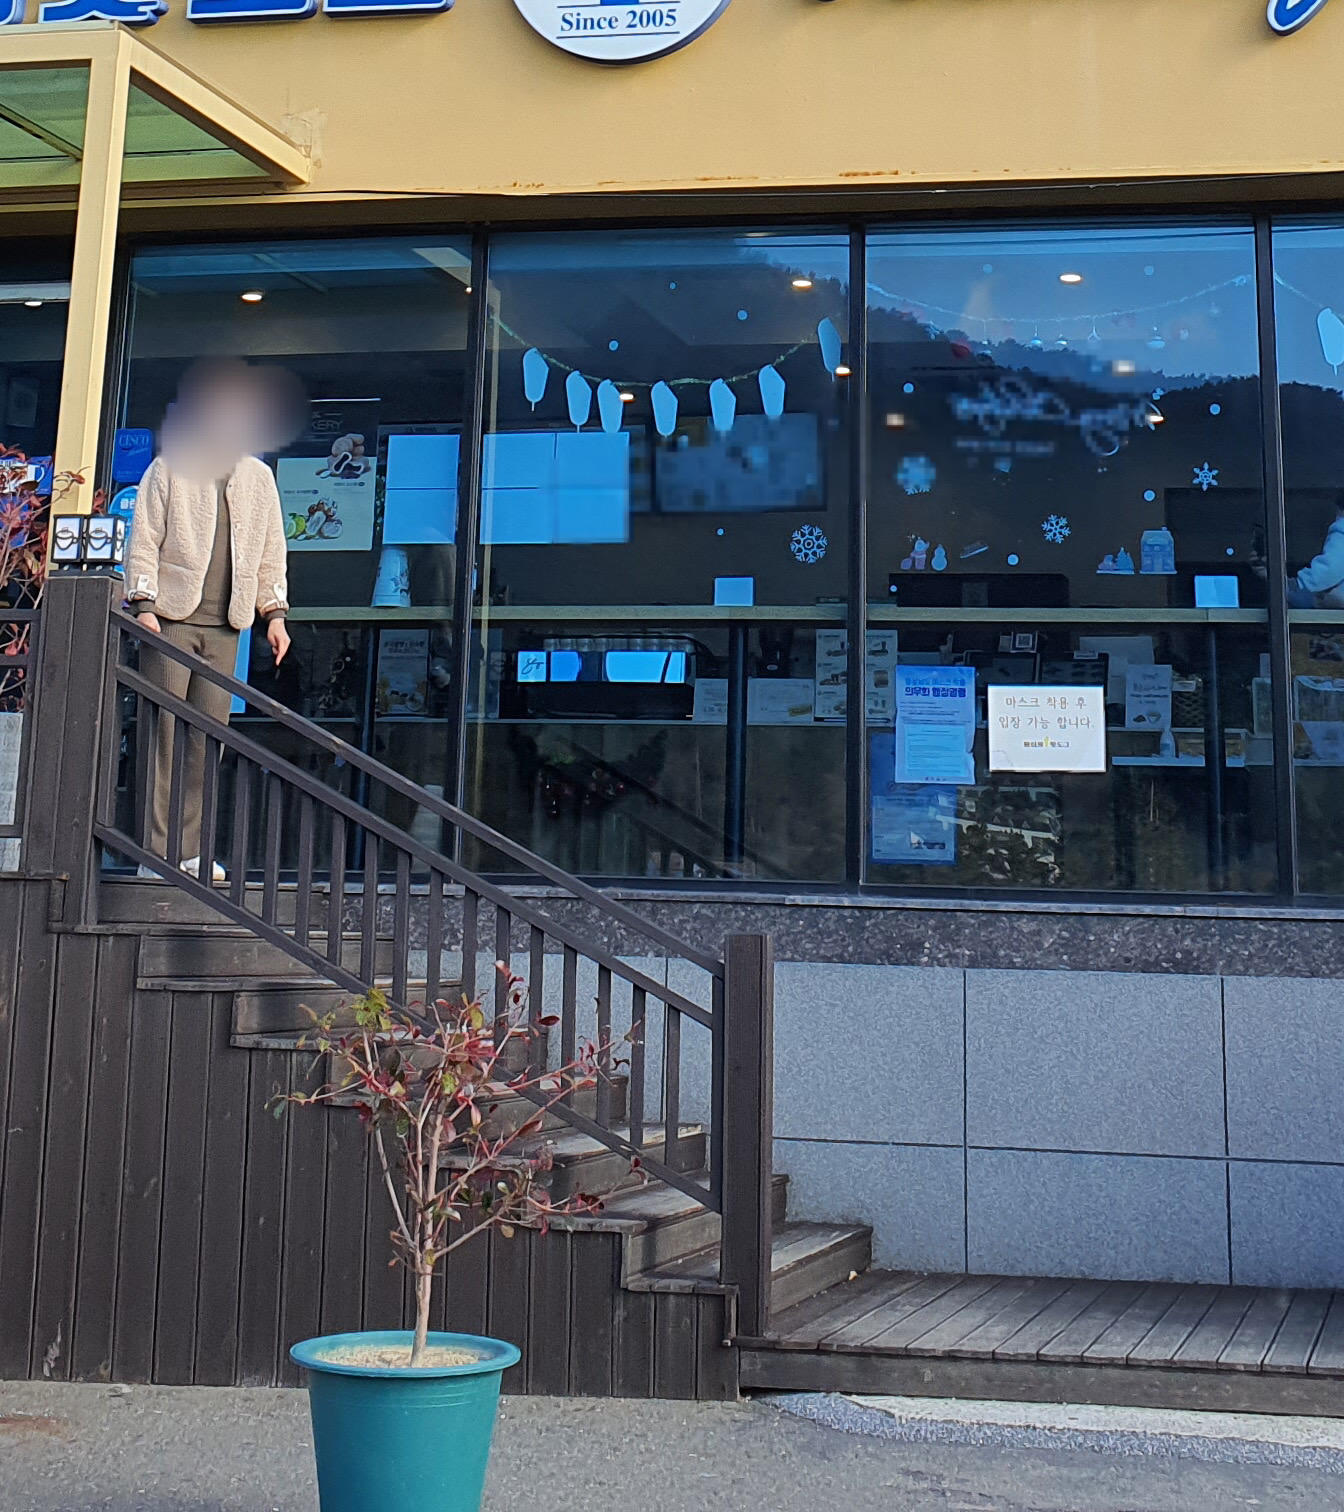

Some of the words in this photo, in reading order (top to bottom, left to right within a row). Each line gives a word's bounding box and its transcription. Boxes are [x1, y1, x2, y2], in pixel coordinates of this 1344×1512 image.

[560, 12, 619, 32] Since
[625, 8, 678, 29] 2005
[1005, 696, 1040, 709] 마스크
[1047, 696, 1069, 710] 착용
[1076, 696, 1087, 710] 후
[999, 715, 1021, 729] 입장
[1027, 715, 1051, 730] 가능
[1057, 715, 1094, 730] 합니다.
